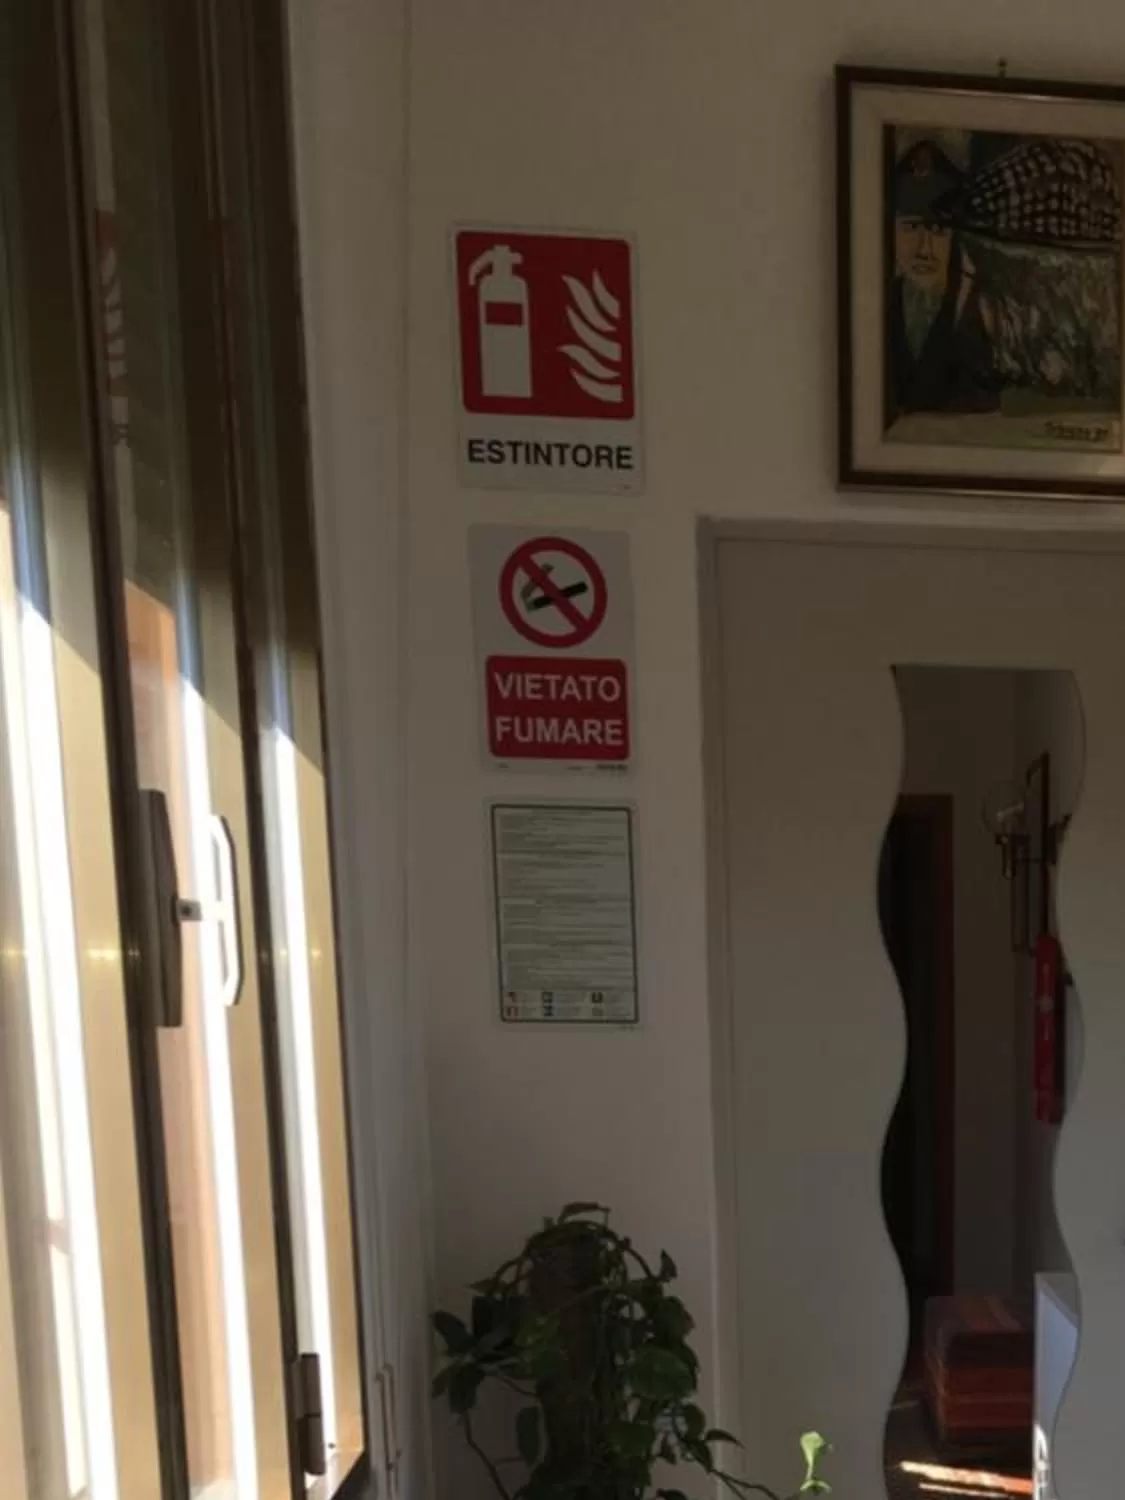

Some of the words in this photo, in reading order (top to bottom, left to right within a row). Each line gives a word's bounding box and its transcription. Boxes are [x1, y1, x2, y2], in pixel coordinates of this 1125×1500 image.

[467, 439, 634, 470] ESTINTORE
[494, 671, 621, 701] VIETATO
[495, 715, 624, 746] FUMARE
